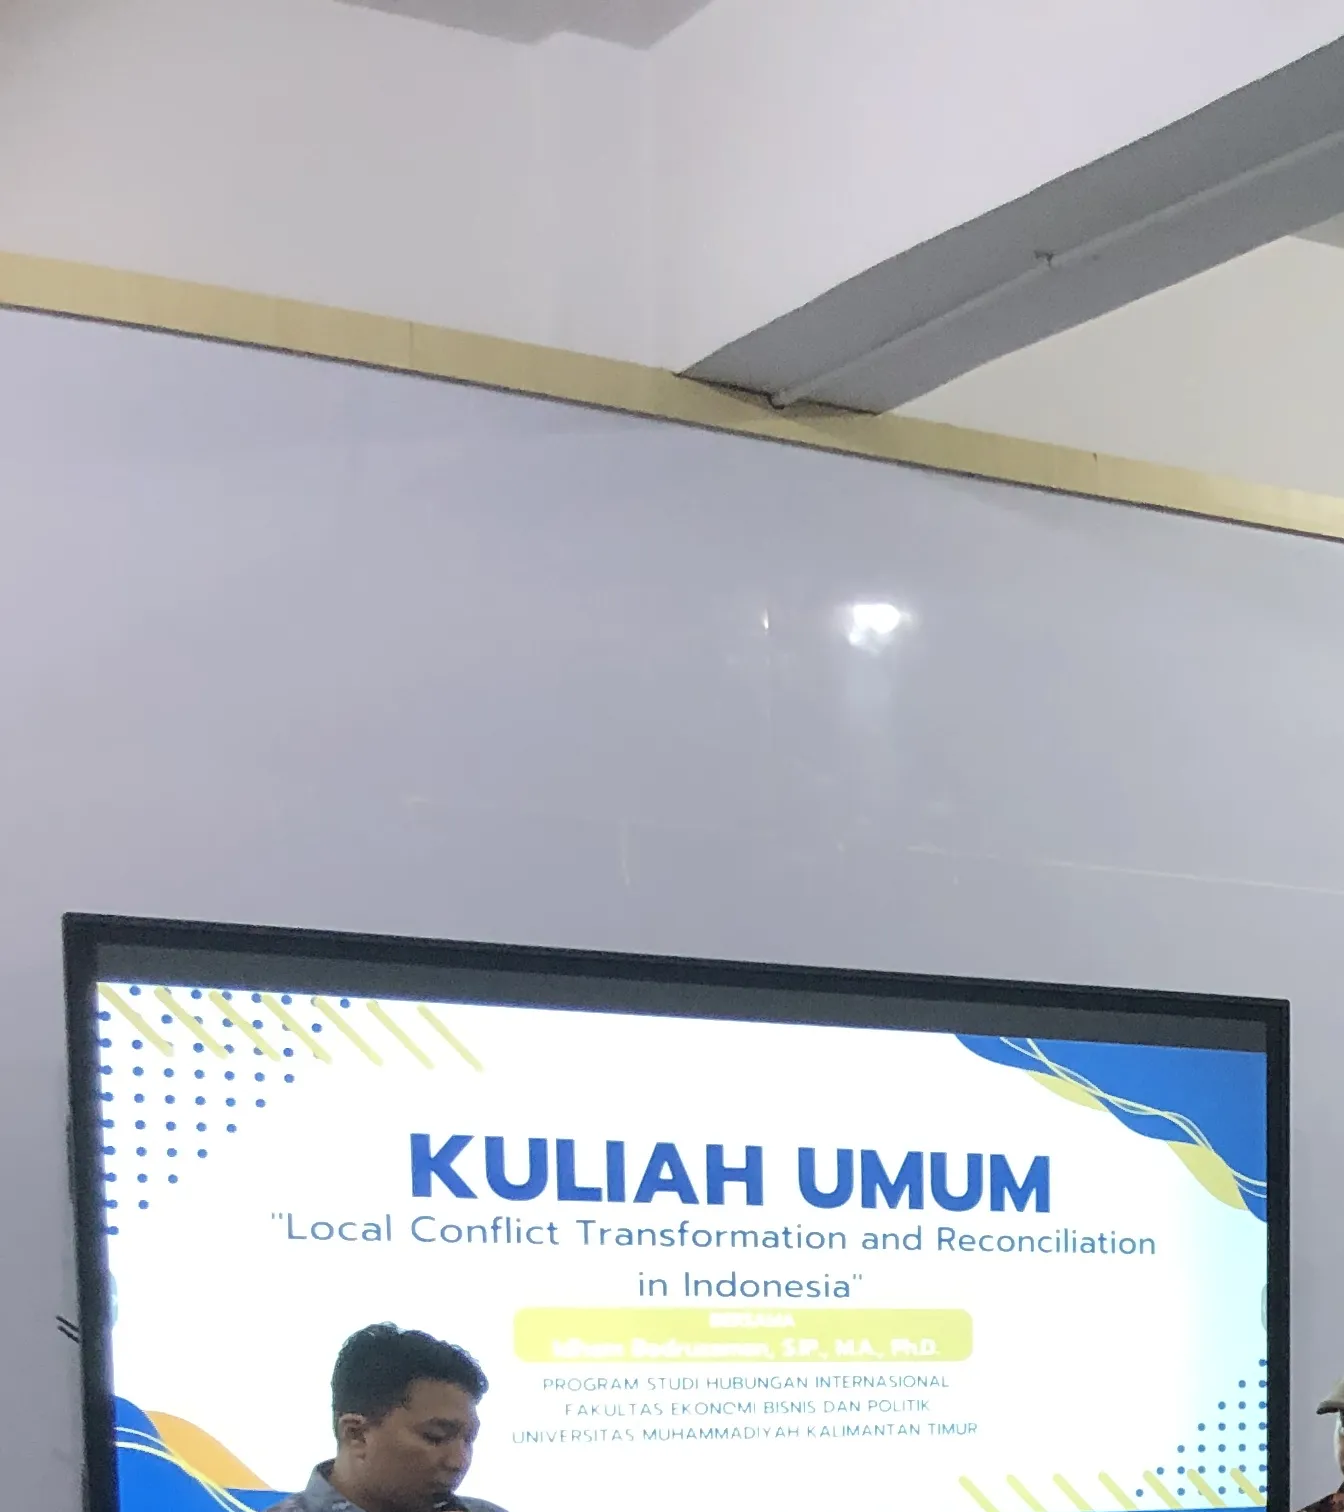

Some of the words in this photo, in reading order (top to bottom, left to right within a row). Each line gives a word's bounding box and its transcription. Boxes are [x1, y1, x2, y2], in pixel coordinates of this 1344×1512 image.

[410, 1133, 764, 1206] KULIAH
[798, 1147, 1050, 1213] UMUM
[272, 1213, 391, 1241] "Local
[411, 1216, 559, 1245] Conflict
[576, 1220, 846, 1249] Transformation
[862, 1225, 921, 1250] and
[938, 1227, 1155, 1254] Reconciliation
[639, 1272, 667, 1296] in
[685, 1271, 862, 1298] Indonesia"
[544, 1378, 638, 1391] PROGRAM
[648, 1377, 698, 1390] STUDI
[707, 1376, 807, 1389] HUBUNGAN
[816, 1375, 949, 1388] INTERNASIONAL
[566, 1403, 663, 1416] FAKULTAS
[672, 1402, 755, 1415] EKONOMI
[764, 1401, 815, 1414] BISNIS
[824, 1401, 860, 1413] DAN
[868, 1400, 929, 1412] POLITIK
[513, 1429, 634, 1443] UNIVERSITAS
[643, 1426, 799, 1441] MUHAMMADIYAH
[807, 1424, 920, 1438] KALIMANTAN
[928, 1423, 977, 1435] TIMUR
